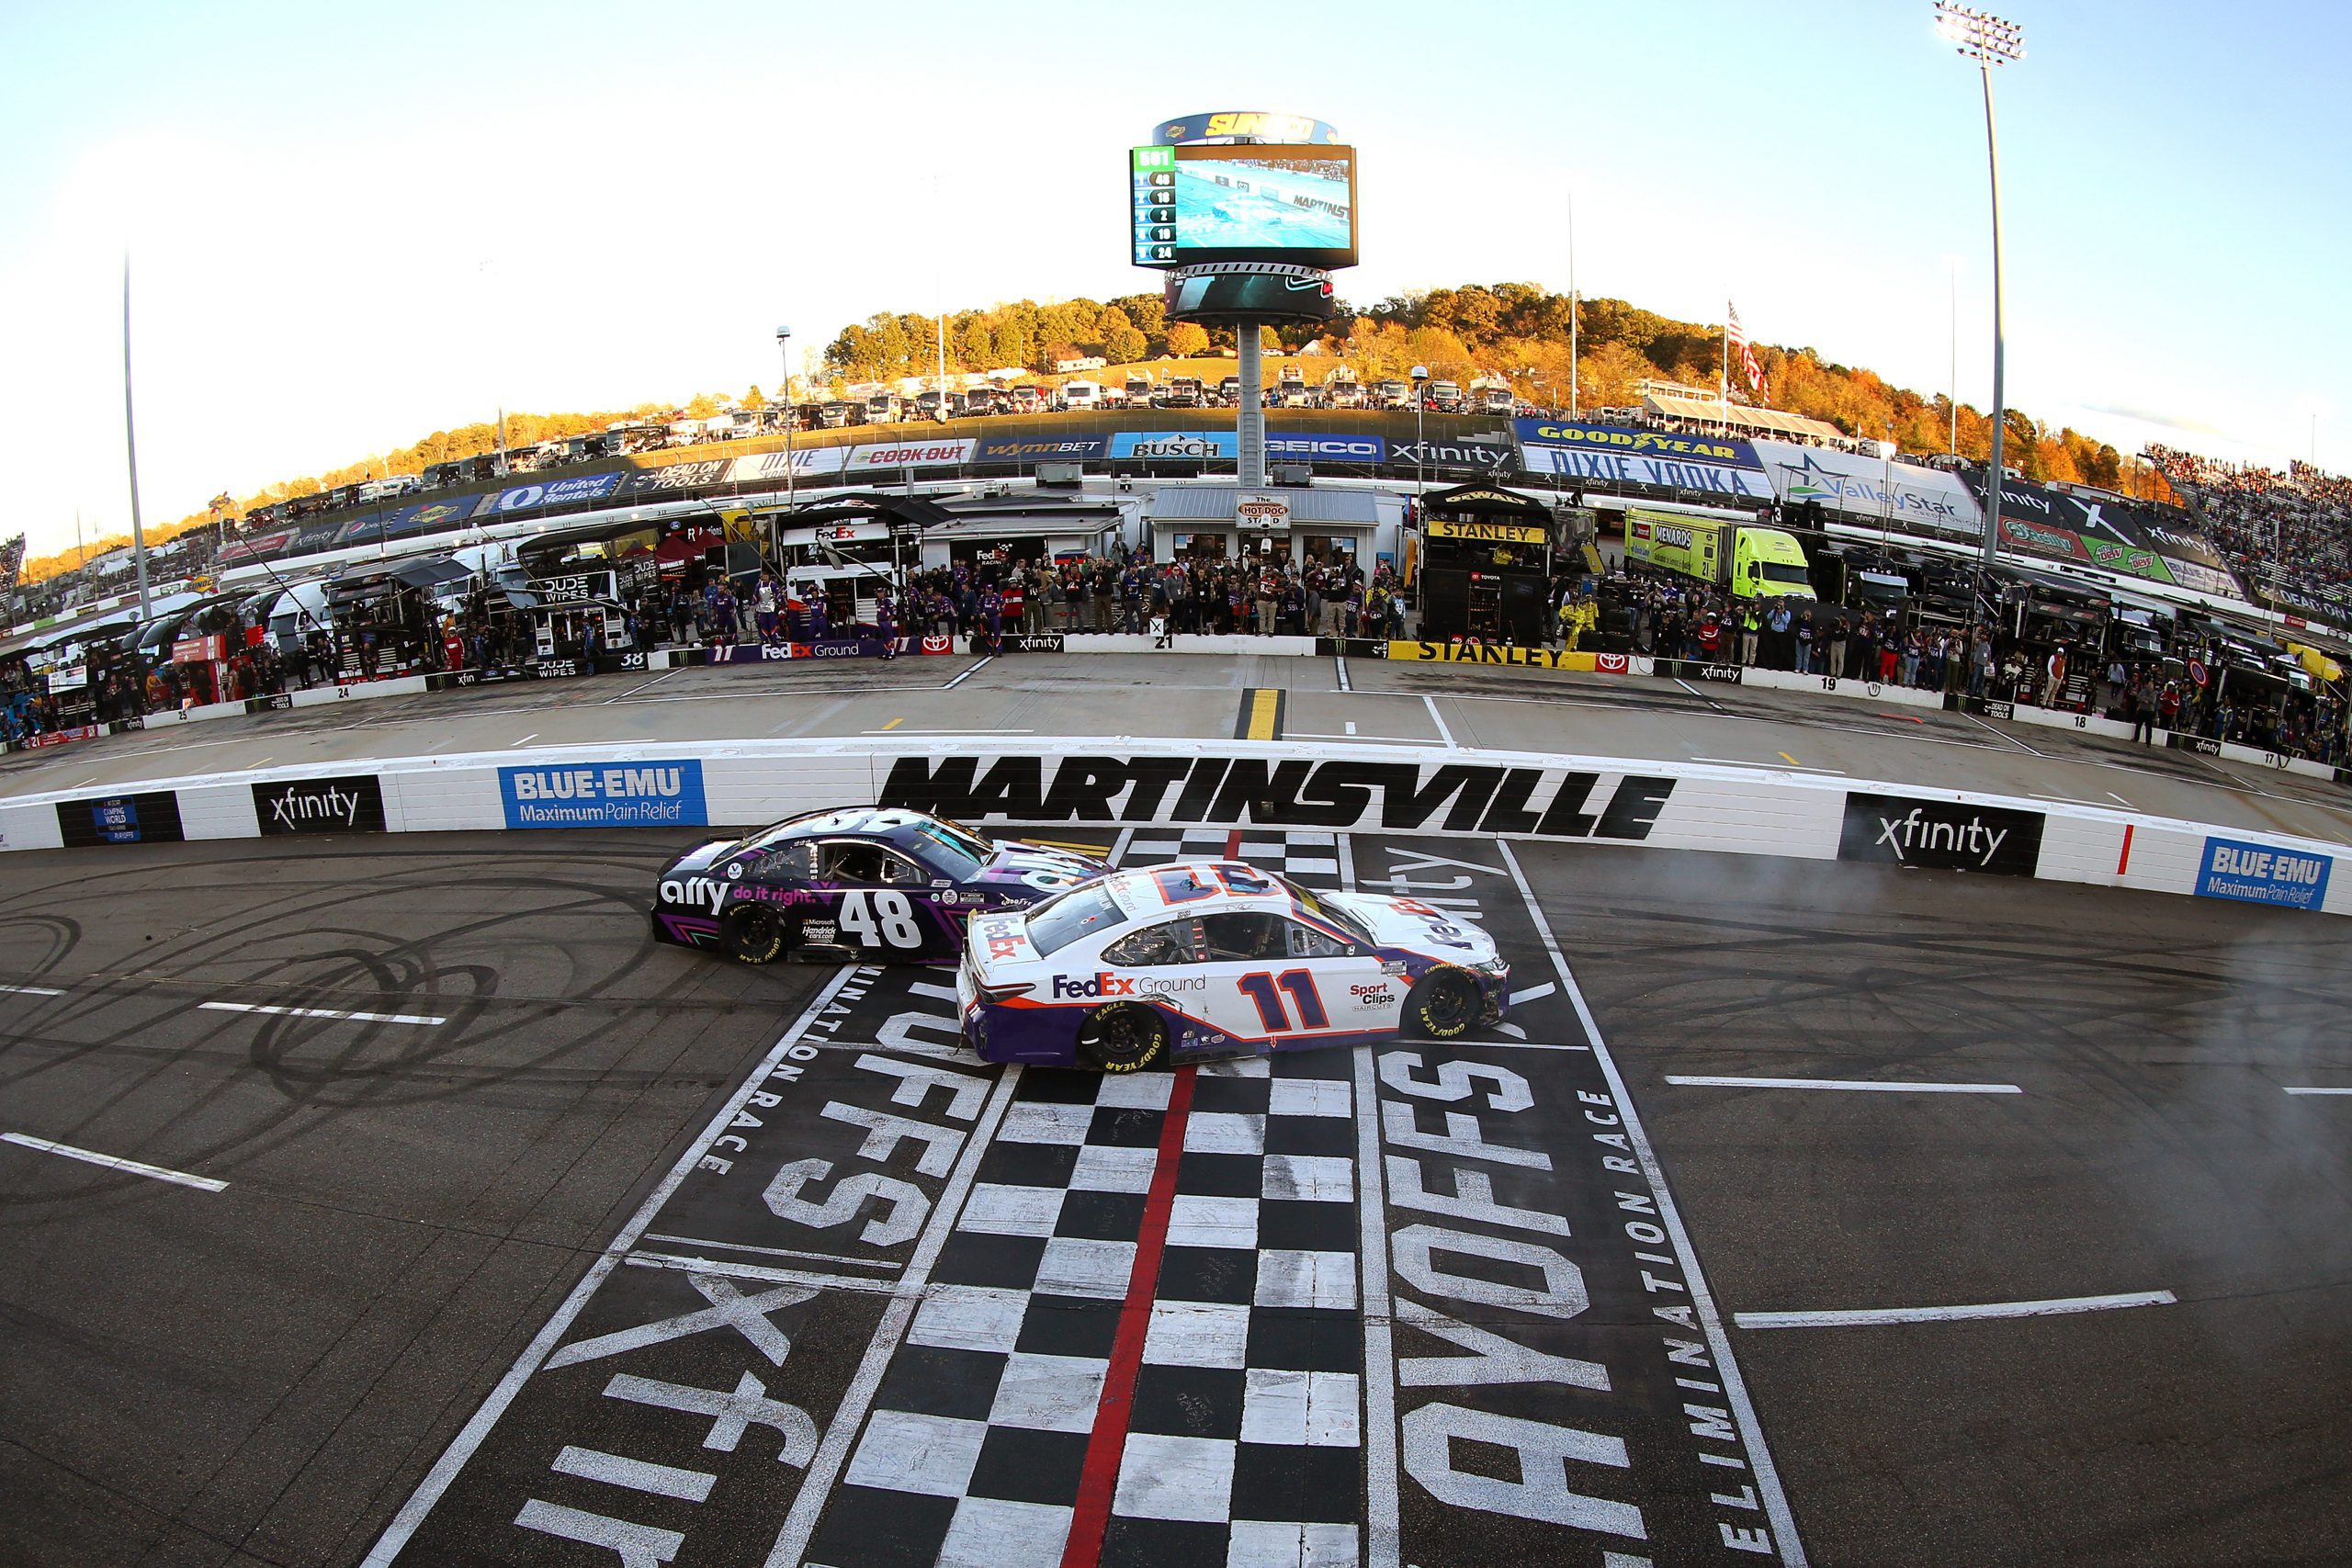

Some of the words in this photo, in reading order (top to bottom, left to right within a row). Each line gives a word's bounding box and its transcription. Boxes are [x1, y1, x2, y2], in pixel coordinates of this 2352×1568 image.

[1139, 150, 1169, 166] 501
[1156, 174, 1170, 186] 48
[1160, 209, 1167, 221] 2
[1159, 246, 1171, 258] 24
[987, 441, 1102, 457] wynnBET
[1131, 442, 1220, 457] BUSCH
[1264, 440, 1377, 455] GEICO
[1537, 425, 1736, 459] GOODYEAR
[869, 447, 922, 464] COOK
[925, 446, 965, 460] OUT
[1392, 441, 1510, 468] xfinity
[658, 463, 699, 479] DEAD
[698, 459, 724, 474] ON
[1487, 469, 1512, 479] xfinity
[1550, 450, 1637, 482] DIXIE
[547, 475, 610, 493] United
[651, 473, 714, 491] TOOLS
[1585, 479, 1609, 490] xfinity
[1640, 458, 1754, 496] VODKA
[539, 487, 606, 505] Rentals
[1974, 485, 2050, 514] xinity
[1244, 505, 1263, 514] HOT
[1264, 506, 1284, 515] DOG
[1247, 516, 1280, 525] STAD
[816, 526, 855, 540] FedEx
[1442, 522, 1530, 541] STANLEY
[1656, 525, 1692, 550] MENARDS
[977, 549, 999, 560] FedE
[634, 559, 656, 573] DUDE
[1702, 561, 1709, 577] 21
[186, 578, 220, 592] SUNOCO
[545, 576, 589, 592] DUDE
[1018, 636, 1061, 653] xfinity
[1155, 635, 1173, 649] 21
[714, 645, 733, 662] 11
[762, 642, 813, 660] FedEx
[814, 642, 859, 658] Ground
[1419, 643, 1563, 668] STANLEY
[620, 652, 644, 667] 38
[539, 668, 576, 678] WIPES
[1701, 665, 1740, 682] xfinity
[1821, 677, 1837, 691] 19
[338, 687, 350, 699] 24
[1991, 703, 2002, 711] DEAD
[1991, 710, 2009, 719] TOOLS
[178, 711, 187, 721] 25
[2075, 716, 2086, 728] 18
[31, 736, 40, 748] 21
[2195, 740, 2220, 755] xfinity
[2265, 753, 2275, 764] 17
[514, 766, 681, 801] BLUE-EMU
[880, 755, 1678, 840] MARTINSVILLE
[103, 807, 125, 816] CAMPING
[269, 785, 358, 829] xfinity
[519, 805, 604, 823] Maximum
[605, 803, 638, 821] Pain
[639, 801, 682, 820] Relief
[104, 814, 127, 824] WORLD
[114, 831, 134, 840] PLAYOFFS
[1875, 808, 2008, 866] xfinity
[2211, 846, 2322, 885] BLUE-EMU
[660, 876, 731, 916] ally
[733, 886, 752, 899] do
[755, 886, 768, 900] it
[772, 887, 816, 906] right.
[2207, 876, 2267, 899] Maximum
[2266, 884, 2288, 902] Pain
[2289, 888, 2315, 904] Relief
[1001, 897, 1035, 908] GOODYE
[839, 891, 922, 949] 48
[801, 926, 837, 937] Hendrick
[1052, 971, 1136, 998] FedEx
[1138, 974, 1206, 994] Ground
[1350, 982, 1388, 998] Sport
[1236, 967, 1330, 1033] 11
[1362, 993, 1396, 1005] Clips
[1094, 999, 1126, 1022] EAGLE
[771, 964, 888, 1083] MINATION
[695, 1089, 784, 1176] RACE
[1576, 1089, 1641, 1176] RACE
[1378, 1049, 1653, 1568] AYOFFS
[1613, 1190, 1774, 1556] ELIMINATION
